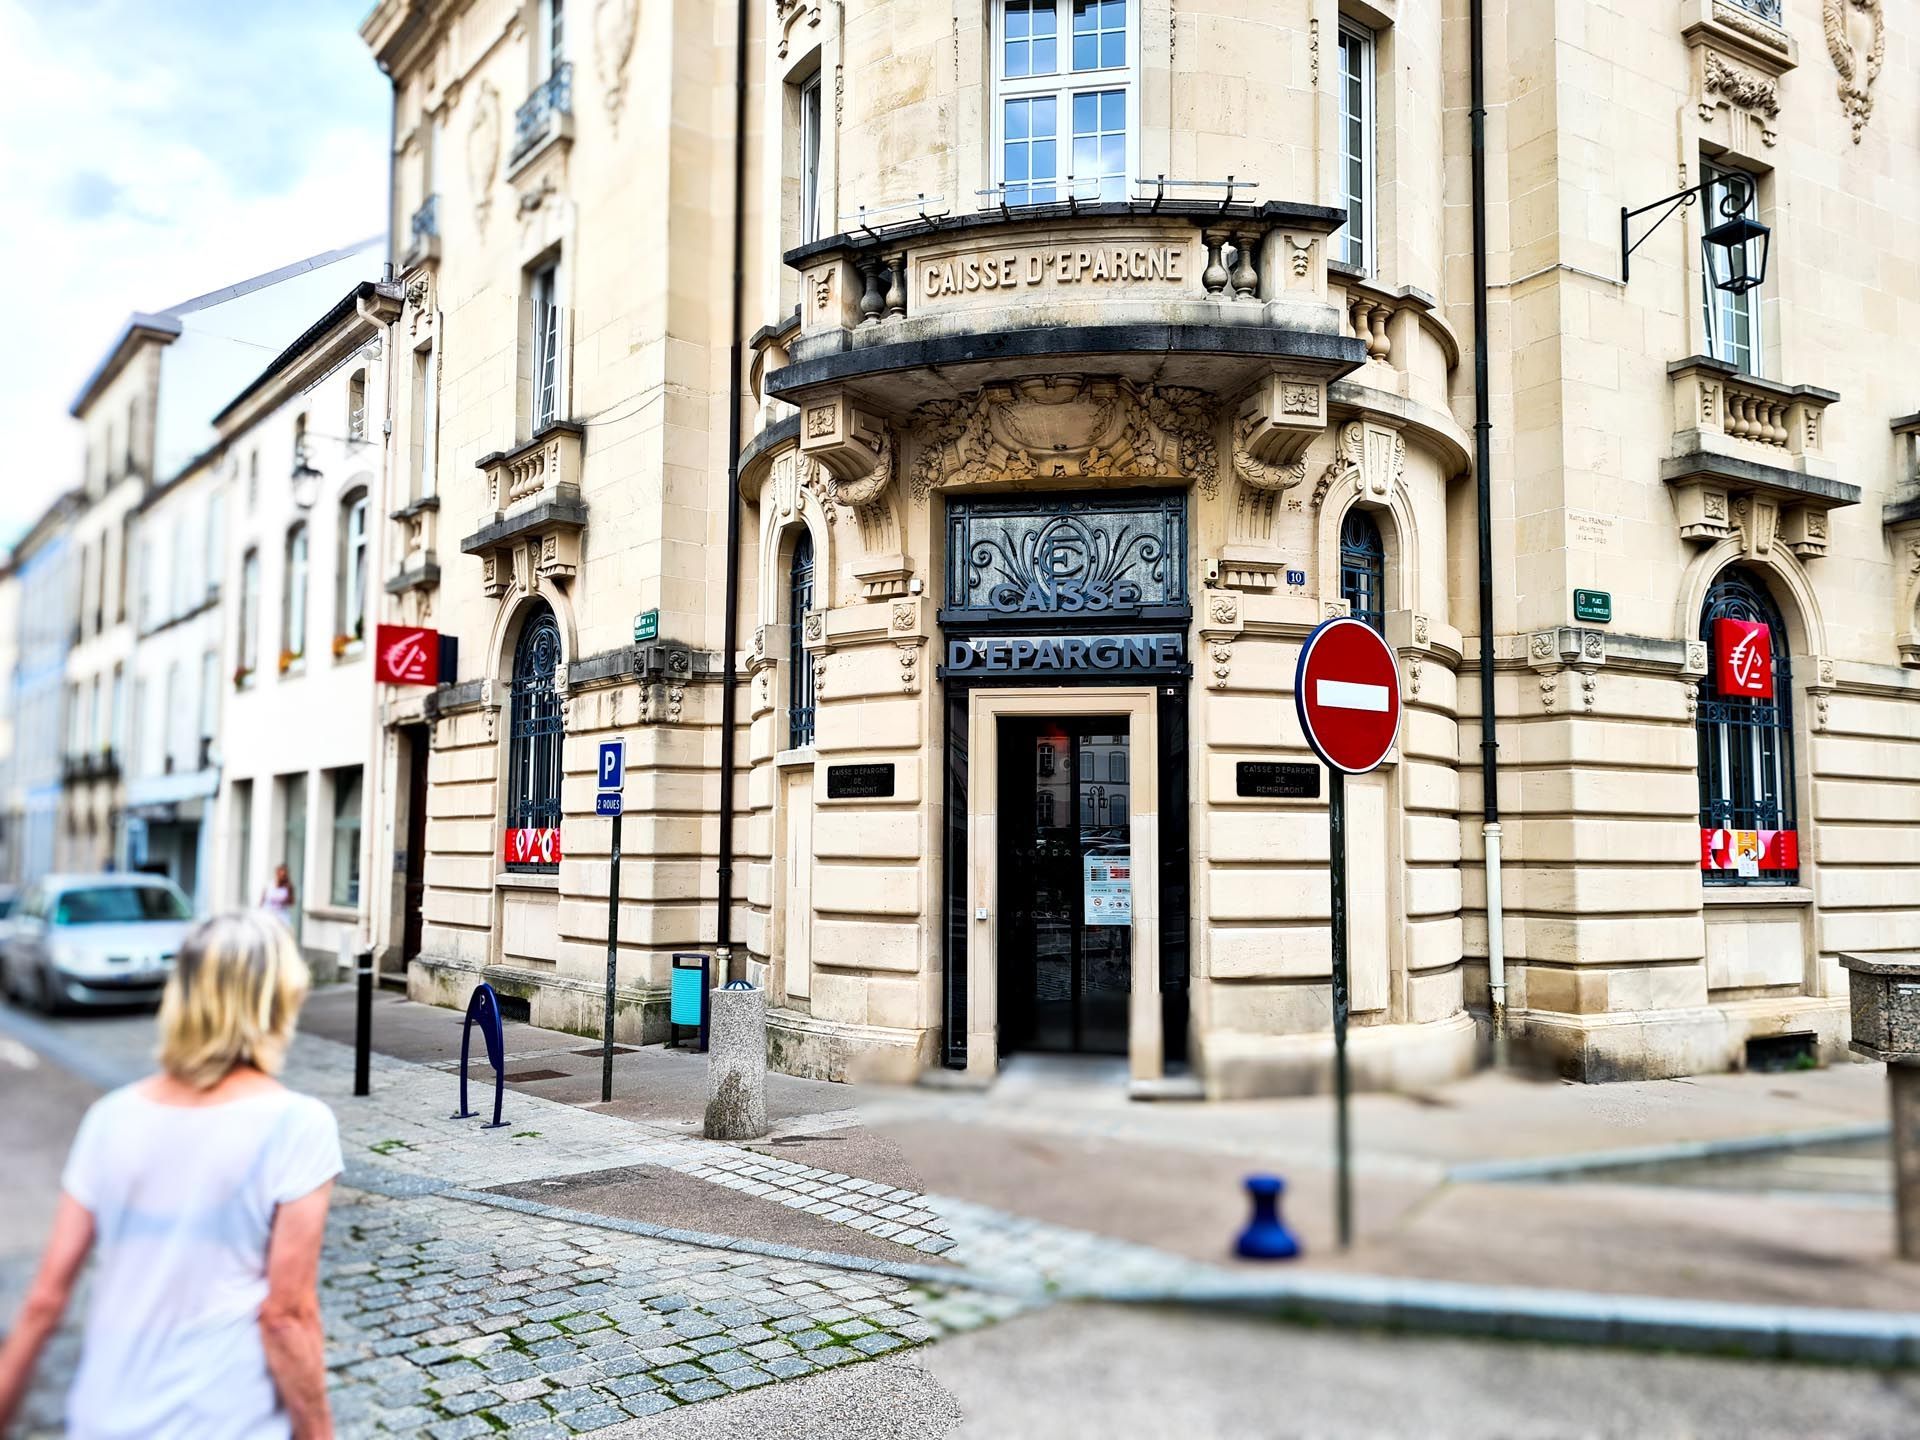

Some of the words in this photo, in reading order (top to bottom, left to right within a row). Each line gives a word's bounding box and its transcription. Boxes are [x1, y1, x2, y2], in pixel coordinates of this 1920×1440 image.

[924, 255, 1017, 297] CAISSE
[1026, 247, 1184, 285] D'EPARGNE
[1291, 572, 1302, 583] 10
[990, 579, 1134, 613] CAISSE
[949, 637, 1178, 670] D'EPARGNE
[604, 750, 616, 780] P
[1243, 765, 1272, 773] CAISSE
[831, 768, 853, 776] CAISSE
[1256, 786, 1305, 794] REMIREMONT
[597, 800, 601, 809] 2
[602, 799, 620, 810] ROUES
